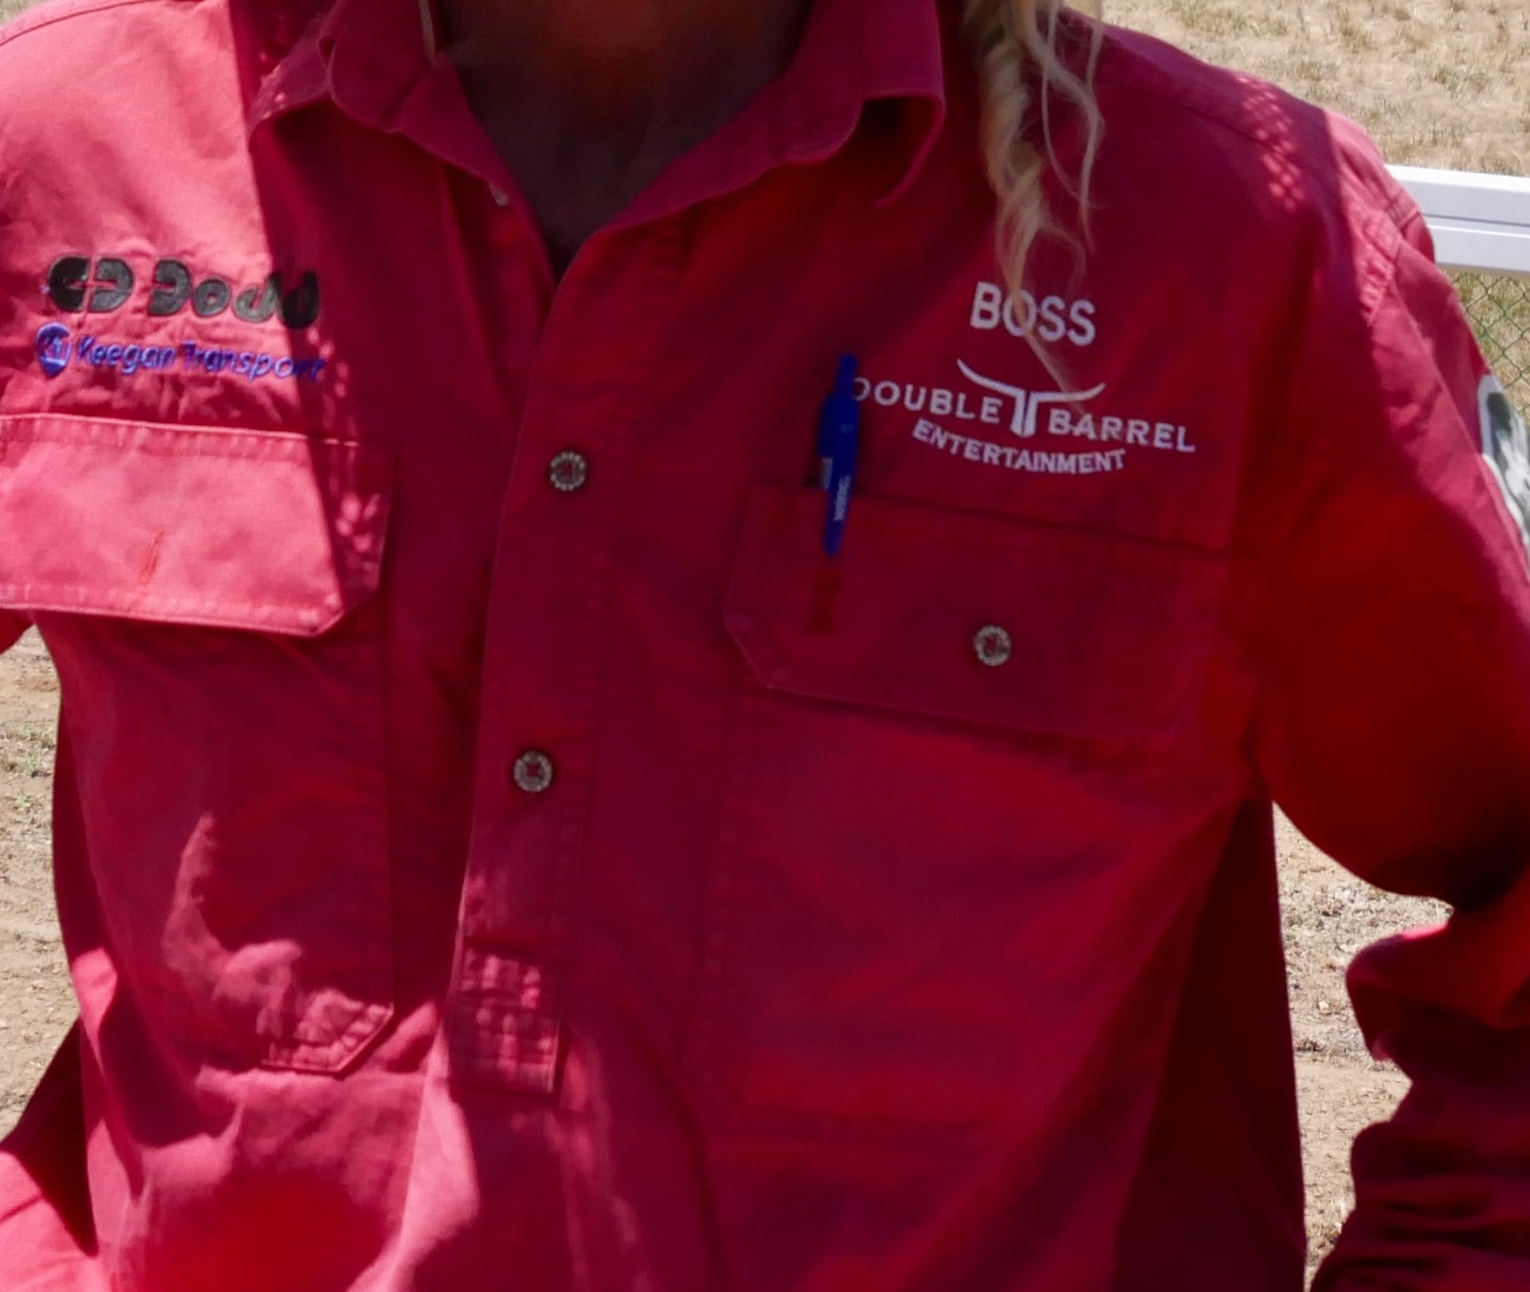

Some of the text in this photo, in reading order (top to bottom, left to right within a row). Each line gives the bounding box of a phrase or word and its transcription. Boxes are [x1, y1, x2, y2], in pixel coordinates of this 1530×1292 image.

[971, 281, 1096, 347] BOSS
[77, 335, 326, 380] Keegan Transport
[912, 418, 1126, 475] ENTERTAINMENT
[1049, 409, 1196, 453] BARREL
